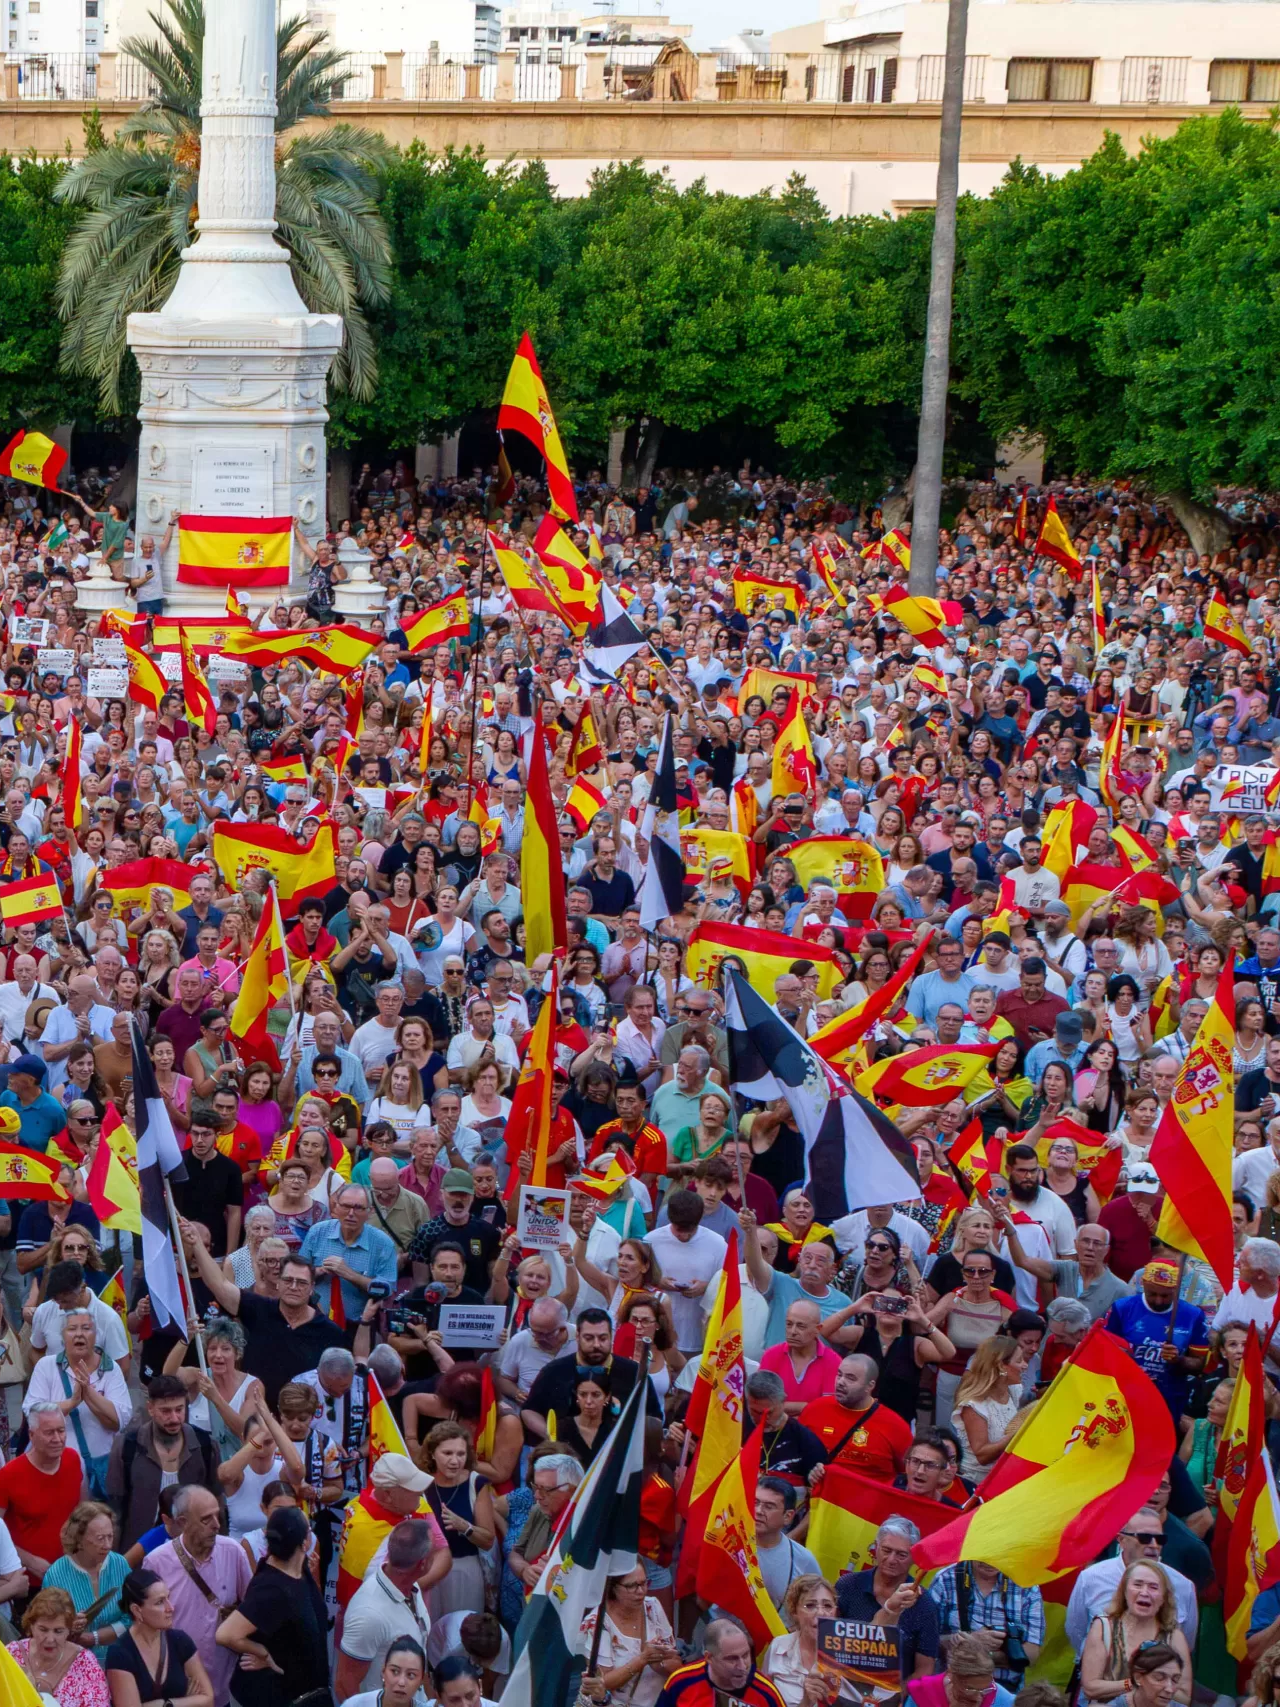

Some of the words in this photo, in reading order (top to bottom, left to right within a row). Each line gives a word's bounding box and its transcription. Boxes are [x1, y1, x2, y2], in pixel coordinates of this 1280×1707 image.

[528, 1217, 559, 1225] UNIDO
[527, 1226, 560, 1234] VENCIDO
[458, 1321, 495, 1331] INVASIÓN!
[834, 1621, 886, 1642] CEUTA
[824, 1635, 842, 1651] ES
[844, 1637, 897, 1657] ESPAÑA
